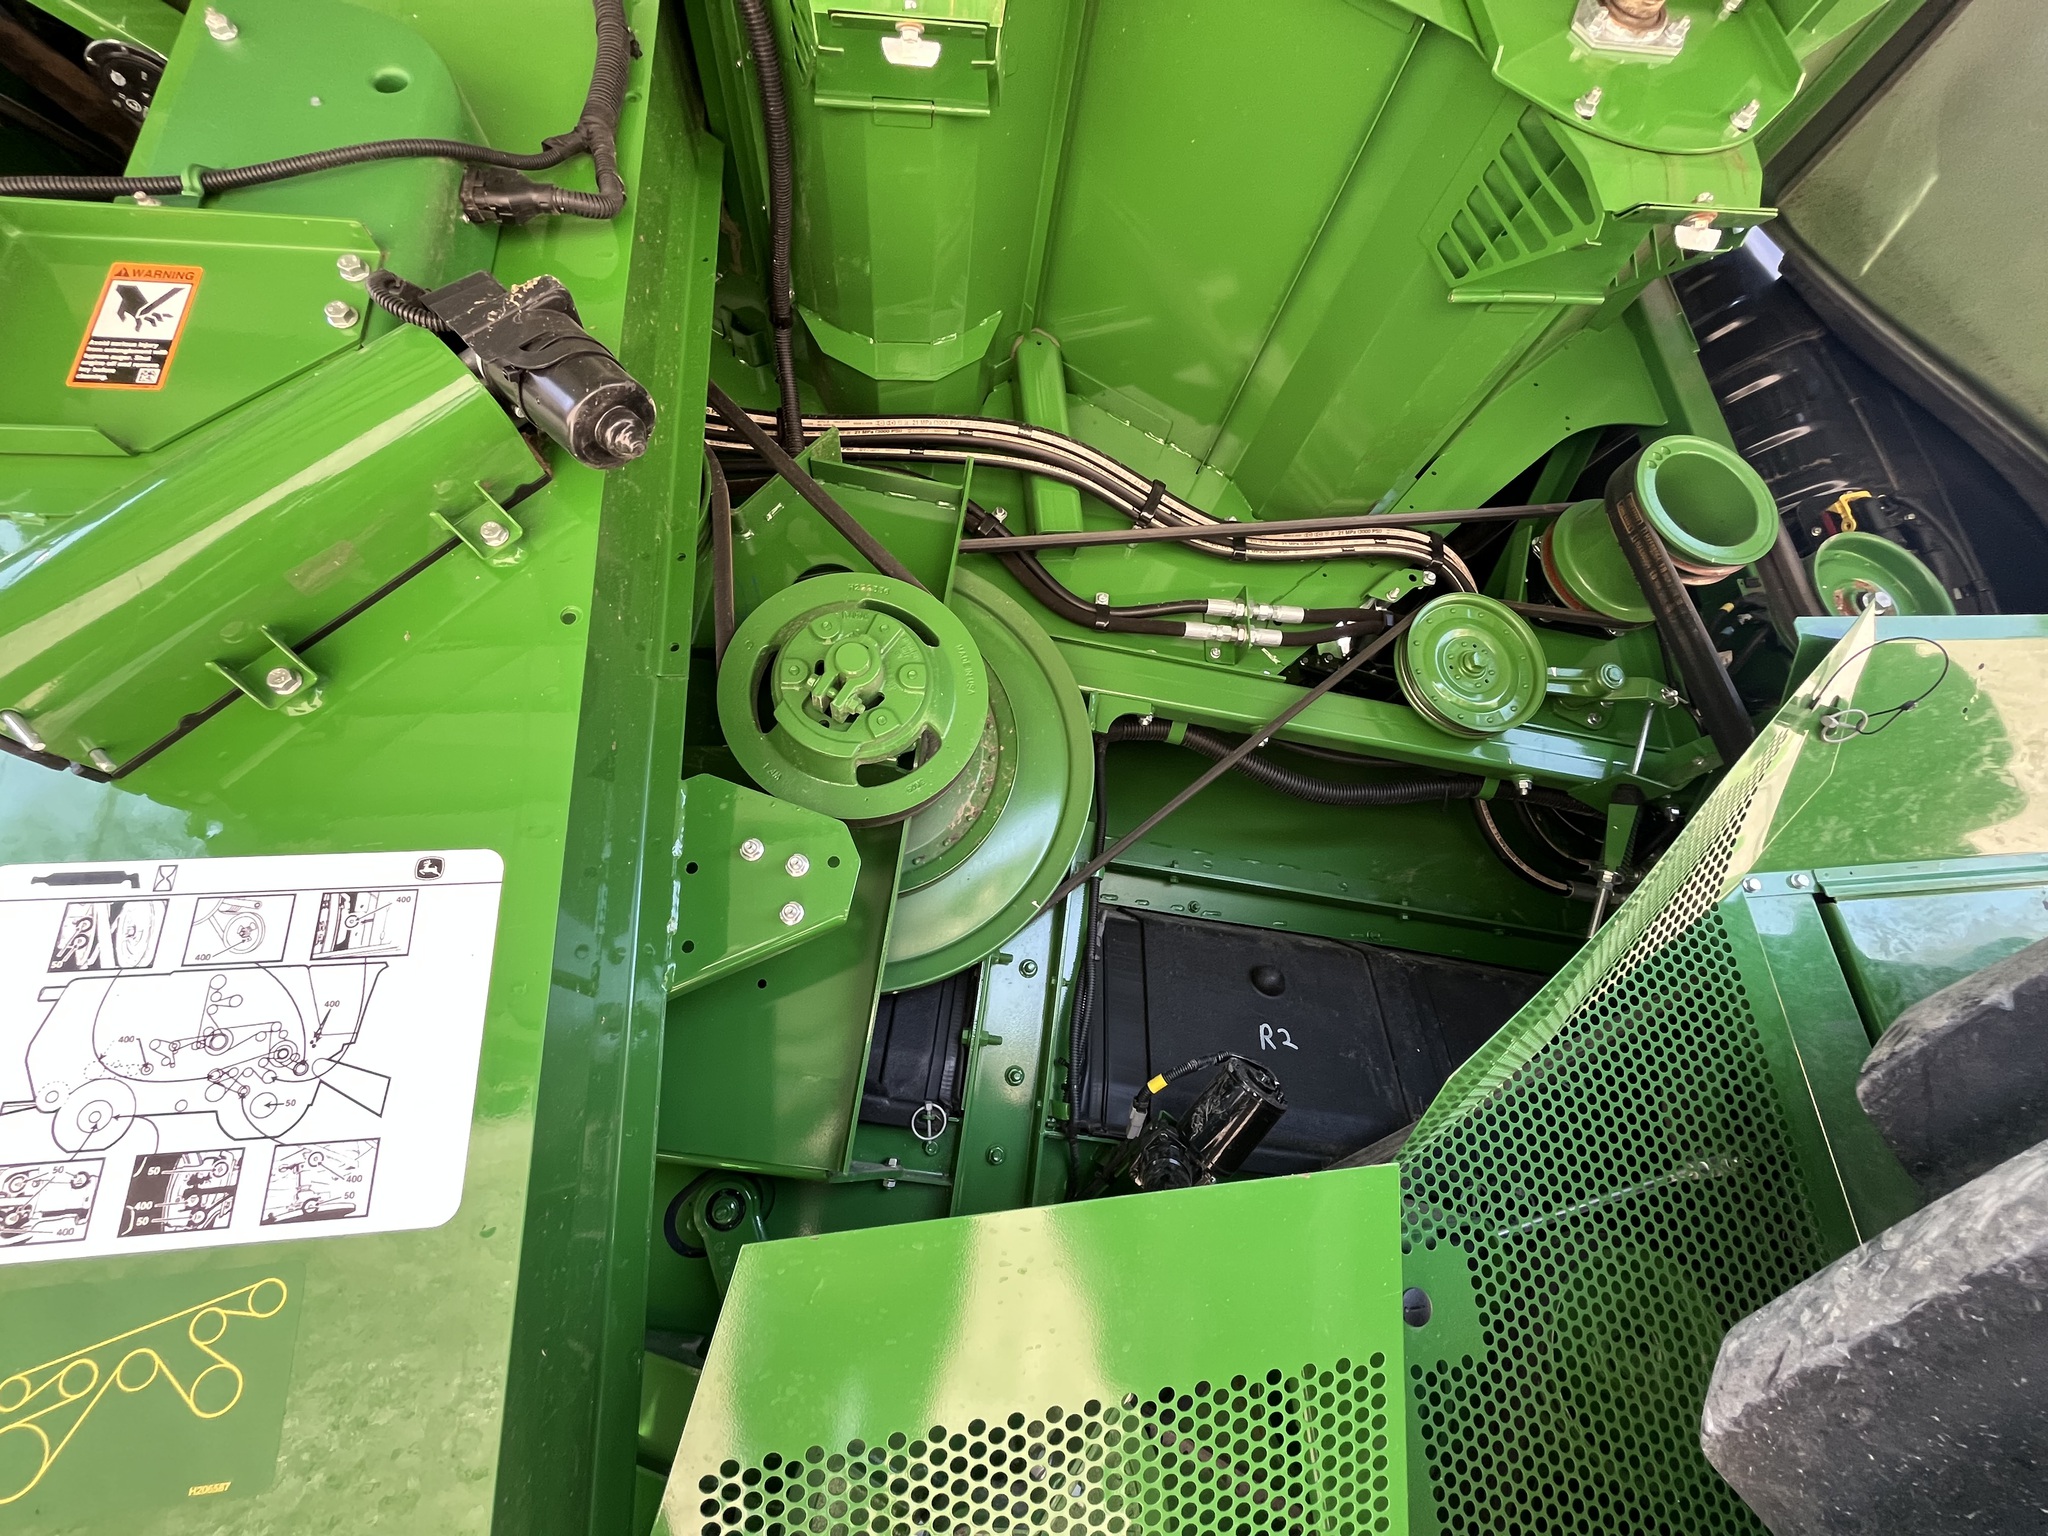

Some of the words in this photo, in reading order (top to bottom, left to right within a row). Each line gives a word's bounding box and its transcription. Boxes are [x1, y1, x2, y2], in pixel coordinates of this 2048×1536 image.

[132, 269, 195, 281] WARNING
[1259, 1023, 1299, 1050] R2
[346, 1175, 363, 1183] 400
[134, 1201, 153, 1211] 400
[56, 1228, 74, 1236] 400
